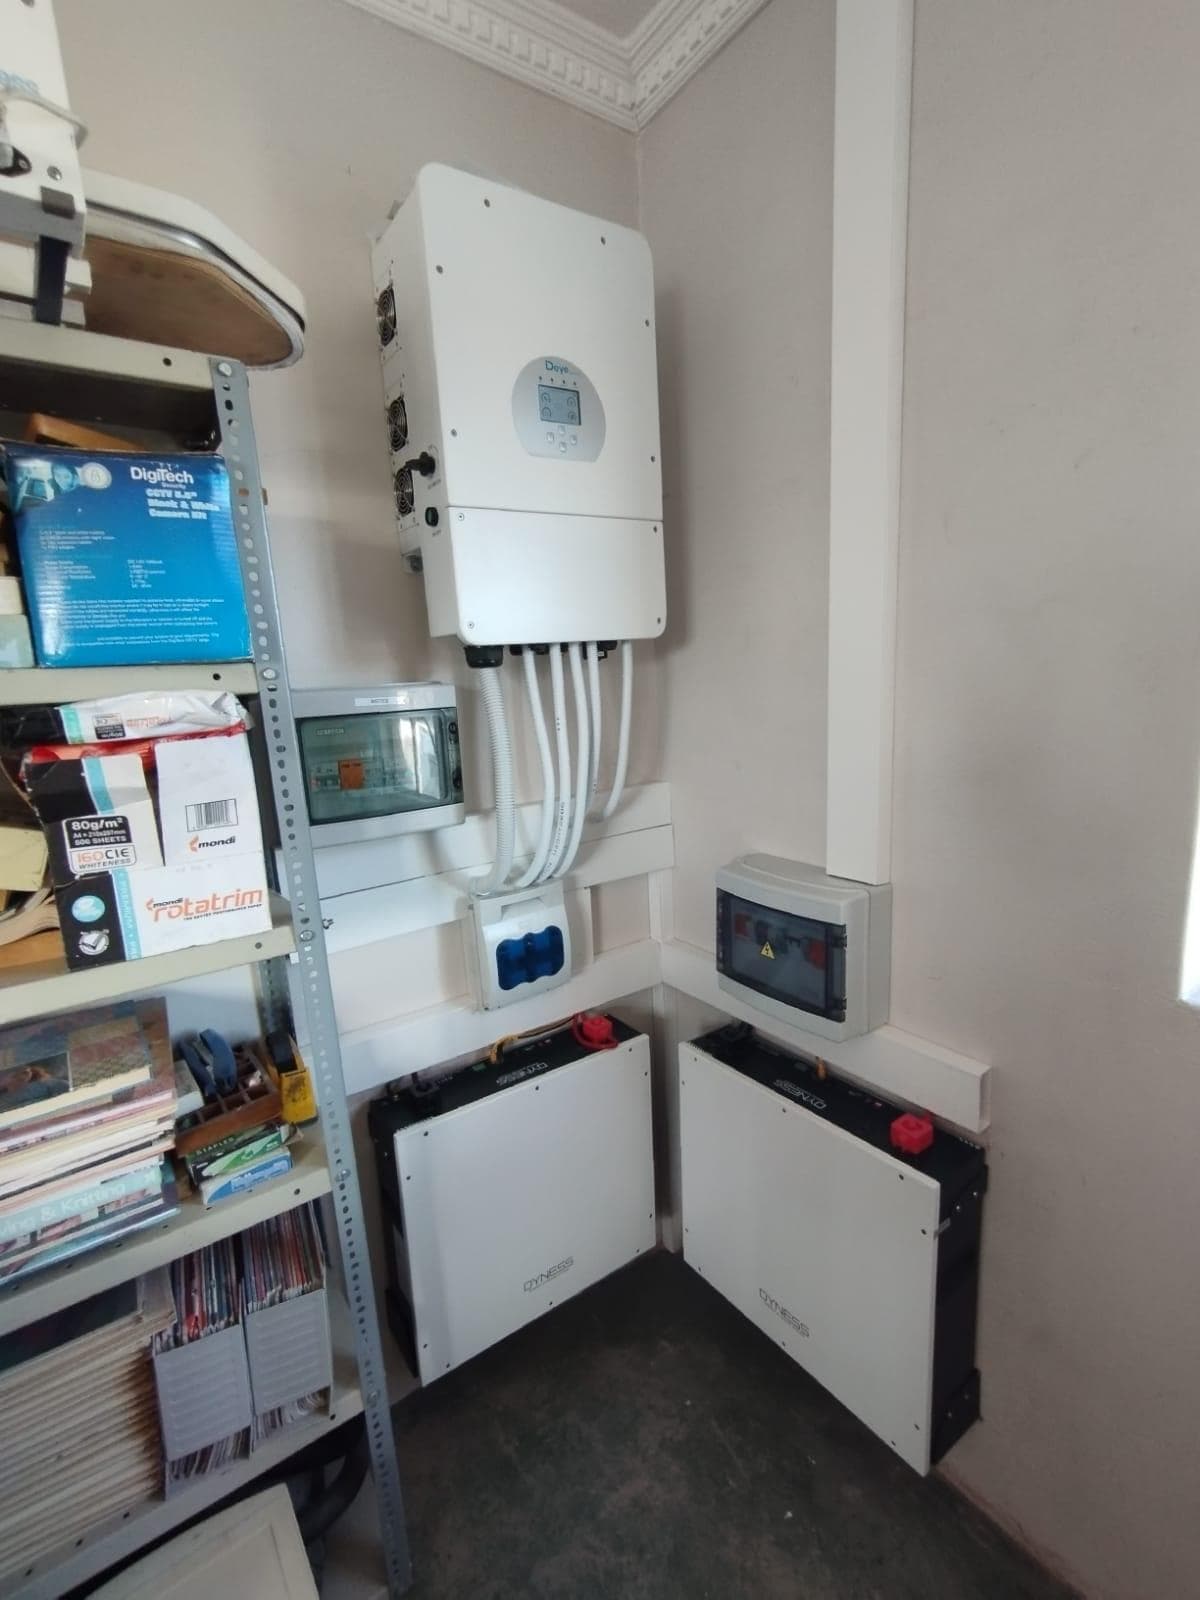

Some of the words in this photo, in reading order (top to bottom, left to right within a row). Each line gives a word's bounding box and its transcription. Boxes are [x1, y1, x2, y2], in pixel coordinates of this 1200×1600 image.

[545, 360, 569, 374] Deye
[130, 466, 194, 484] DigiTech
[92, 835, 127, 844] SHEETS
[199, 835, 236, 848] mondi
[79, 858, 131, 869] WHITENESS
[153, 897, 183, 908] mondi
[153, 888, 262, 922] rotatrim
